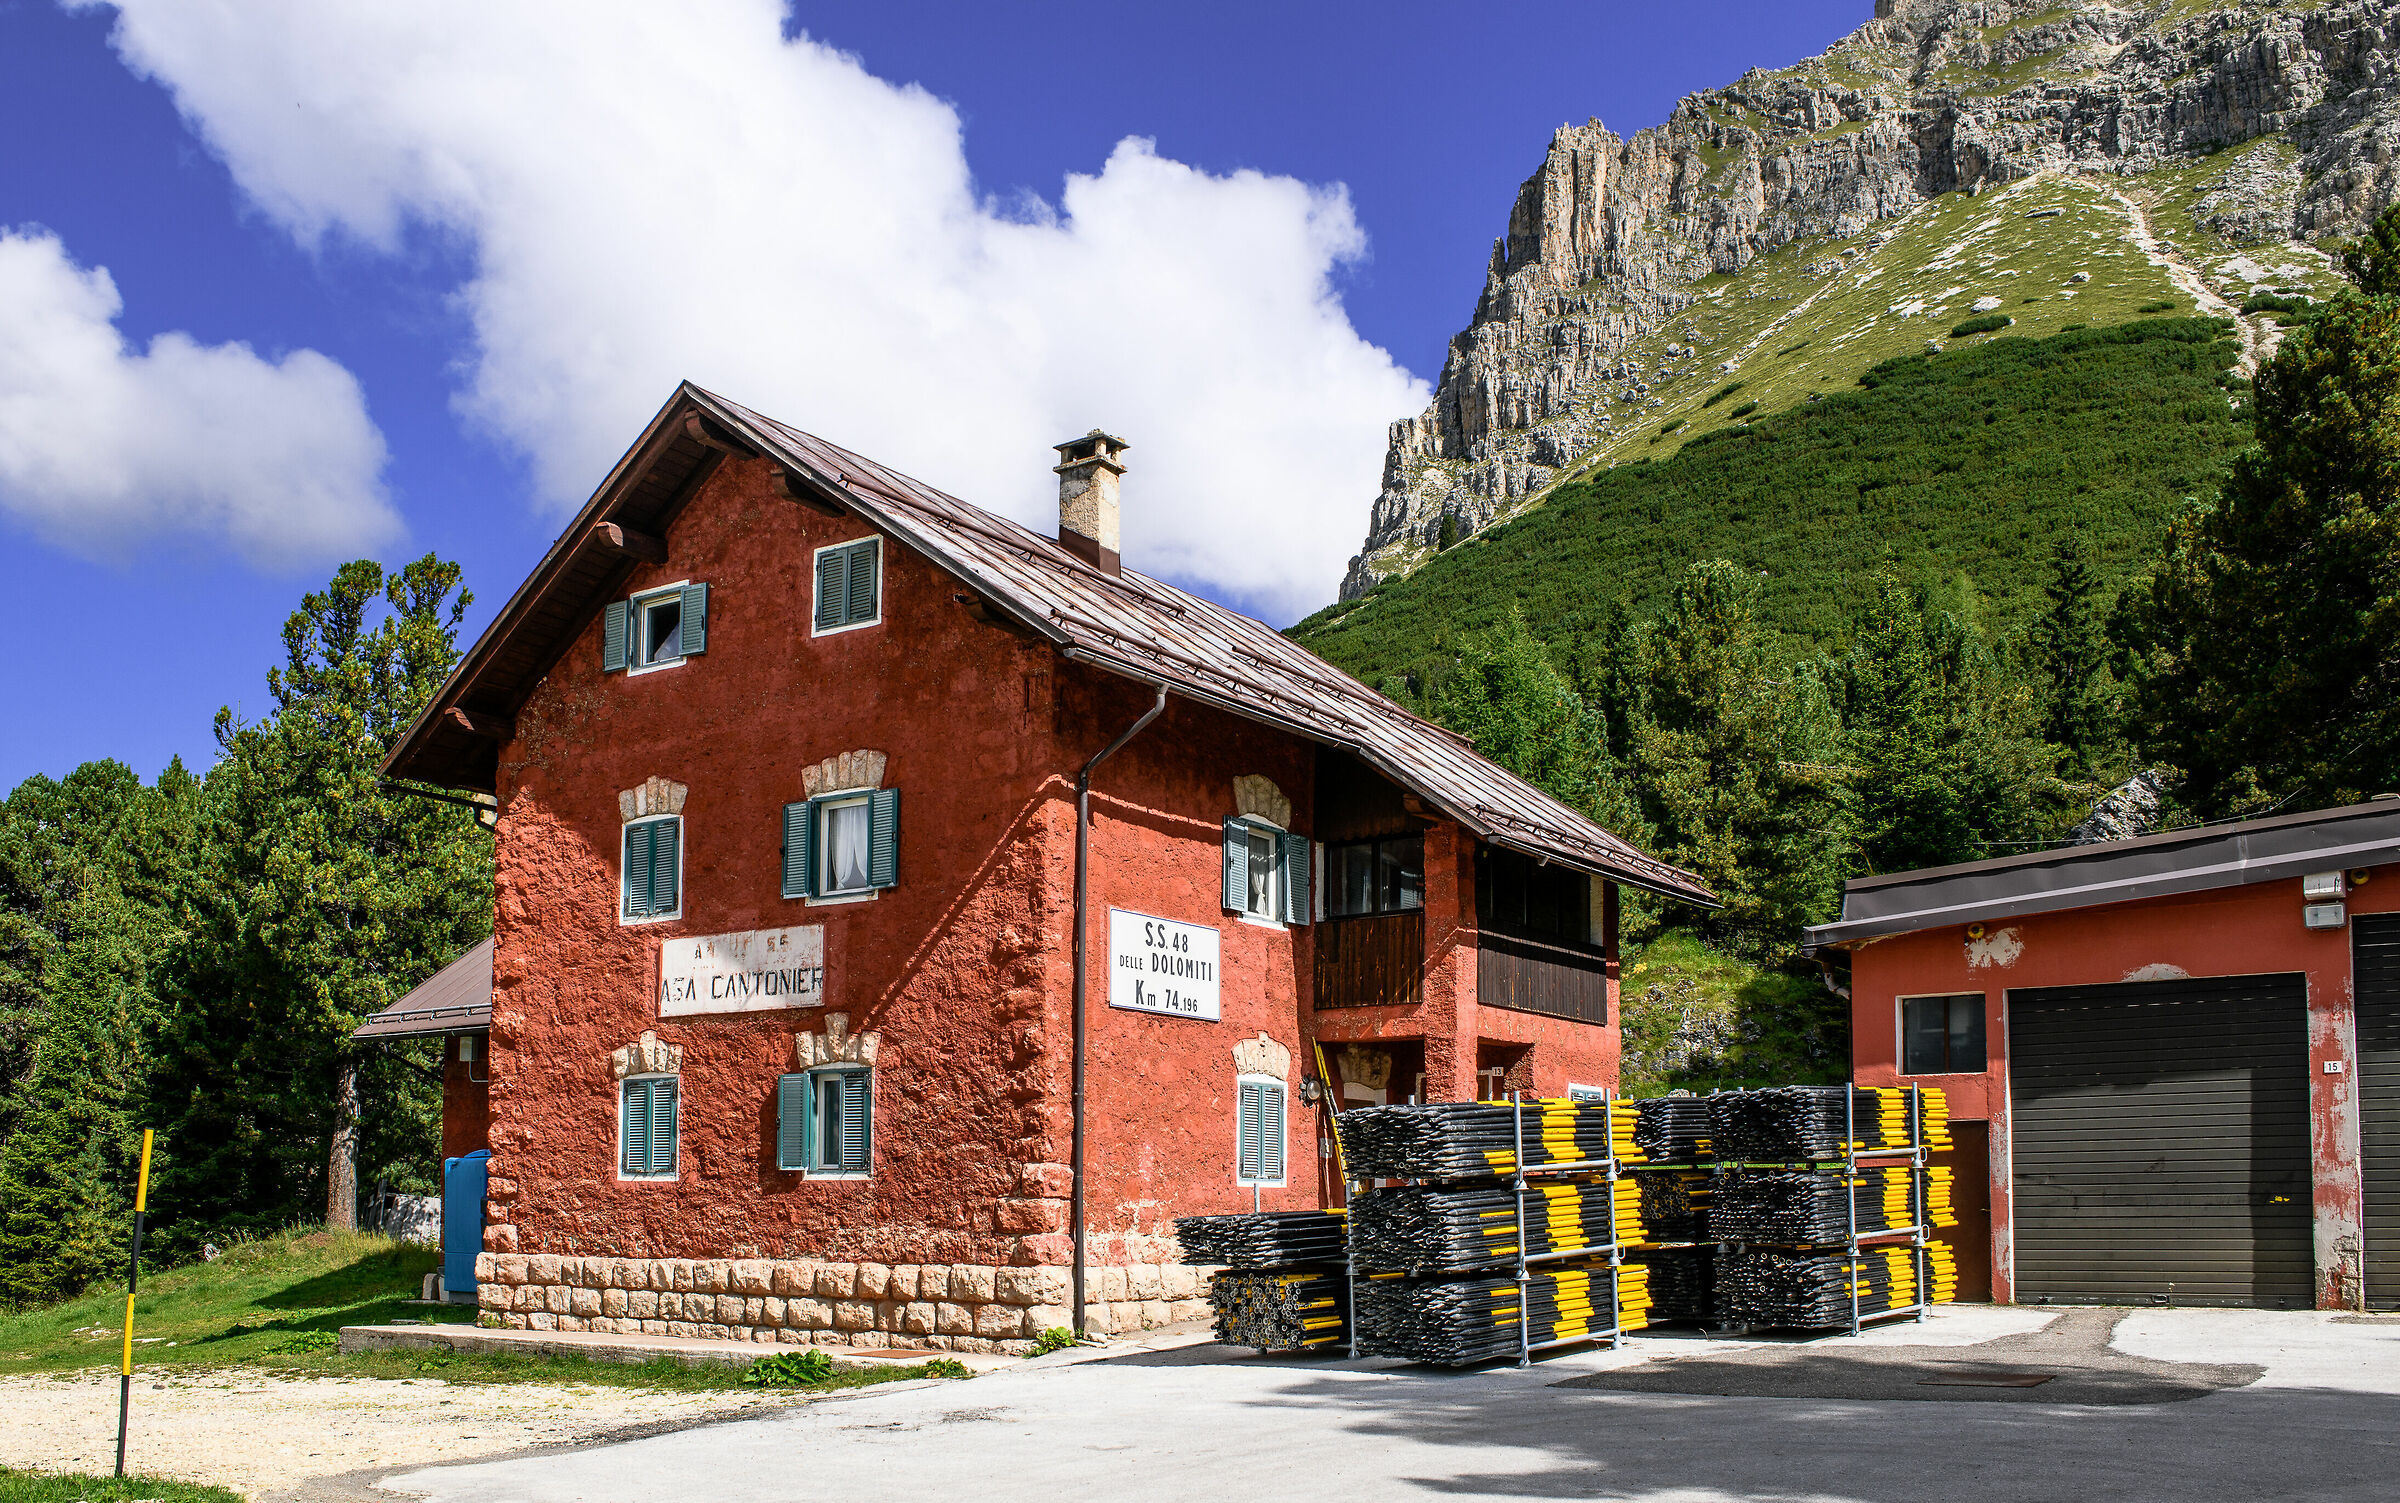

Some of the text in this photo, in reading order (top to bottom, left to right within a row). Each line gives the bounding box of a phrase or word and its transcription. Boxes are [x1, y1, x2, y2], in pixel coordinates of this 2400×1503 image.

[1172, 932, 1188, 953] 48
[1119, 952, 1212, 982] DELLE DOLOMITI
[1135, 979, 1156, 1007] Km
[2328, 1063, 2338, 1071] 15
